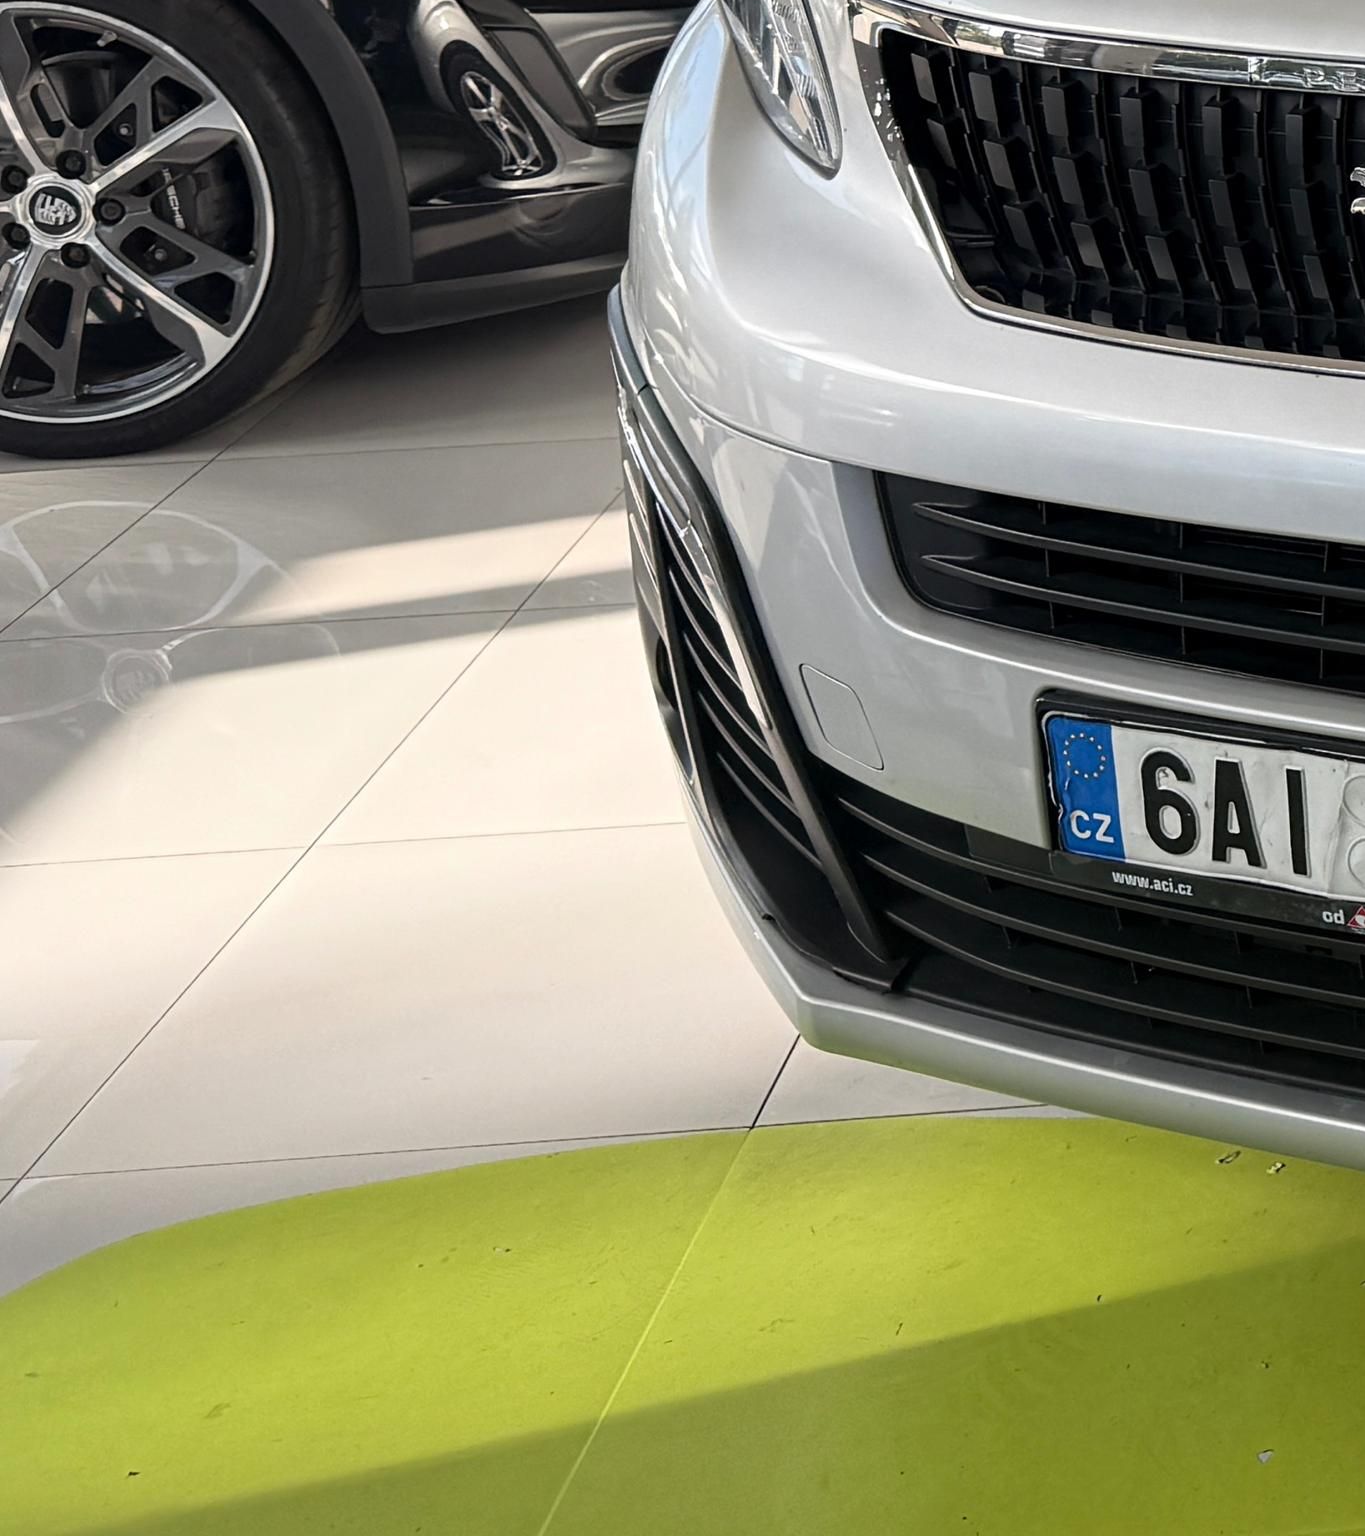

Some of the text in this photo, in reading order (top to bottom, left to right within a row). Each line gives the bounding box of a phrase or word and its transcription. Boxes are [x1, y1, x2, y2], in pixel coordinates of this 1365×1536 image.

[1070, 810, 1115, 843] CZ
[1112, 871, 1193, 896] www.aci.cz
[1322, 909, 1345, 925] od
